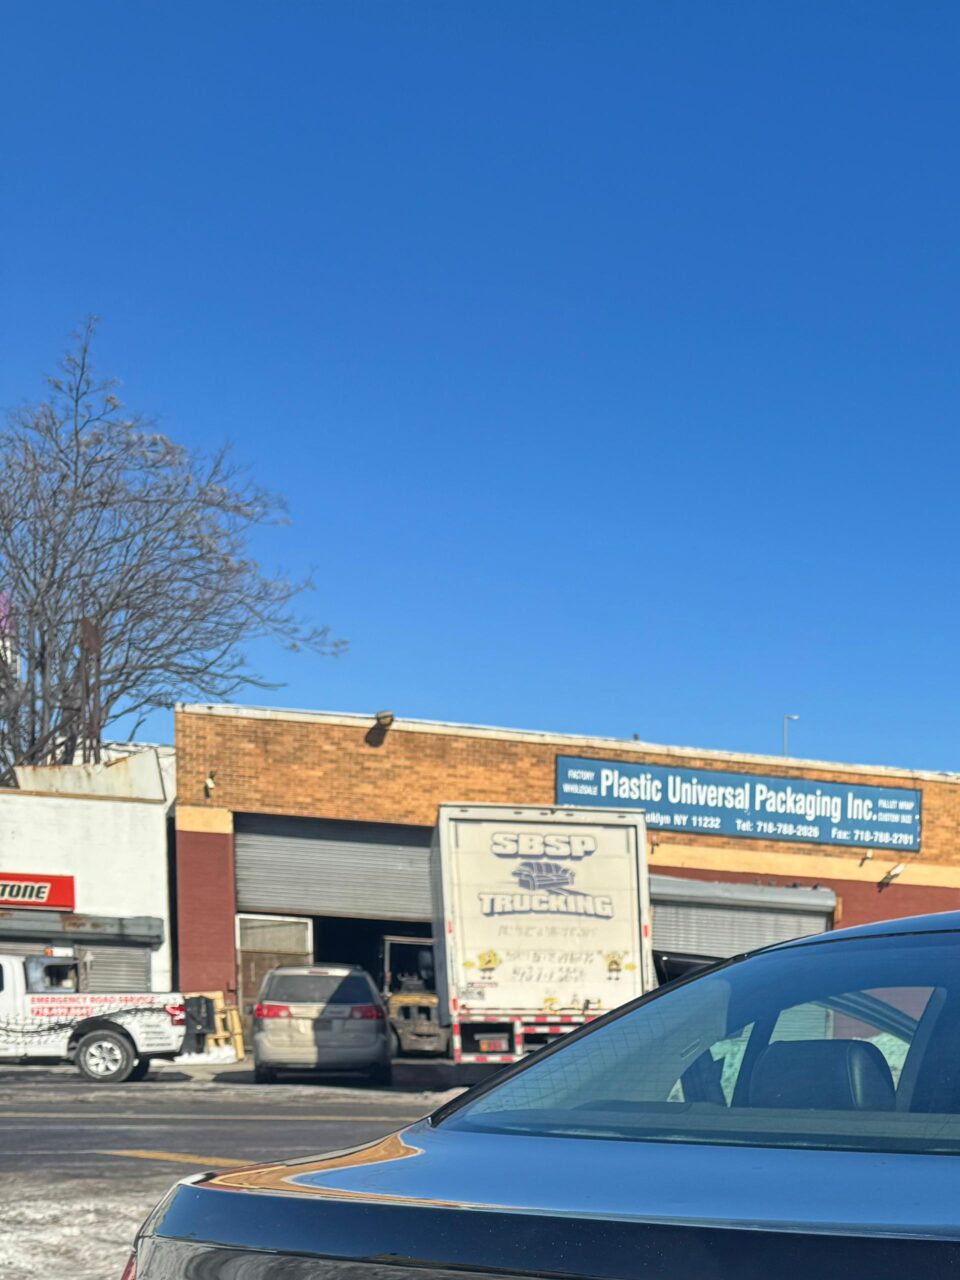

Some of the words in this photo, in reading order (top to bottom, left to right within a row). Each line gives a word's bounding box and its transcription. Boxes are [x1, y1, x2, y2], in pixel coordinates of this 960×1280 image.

[600, 768, 662, 802] Plastic
[667, 775, 750, 809] Universal
[754, 783, 842, 823] Packaging
[846, 792, 877, 821] Inc.
[645, 812, 671, 826] oklyn
[673, 814, 689, 826] NY
[691, 816, 721, 829] 11232
[735, 819, 753, 832] Tel:
[831, 827, 851, 840] Fax:
[491, 832, 598, 861] SBSP
[0, 883, 48, 899] TONE
[478, 892, 614, 920] TRUCKING
[31, 996, 87, 1004] EMERGENCY
